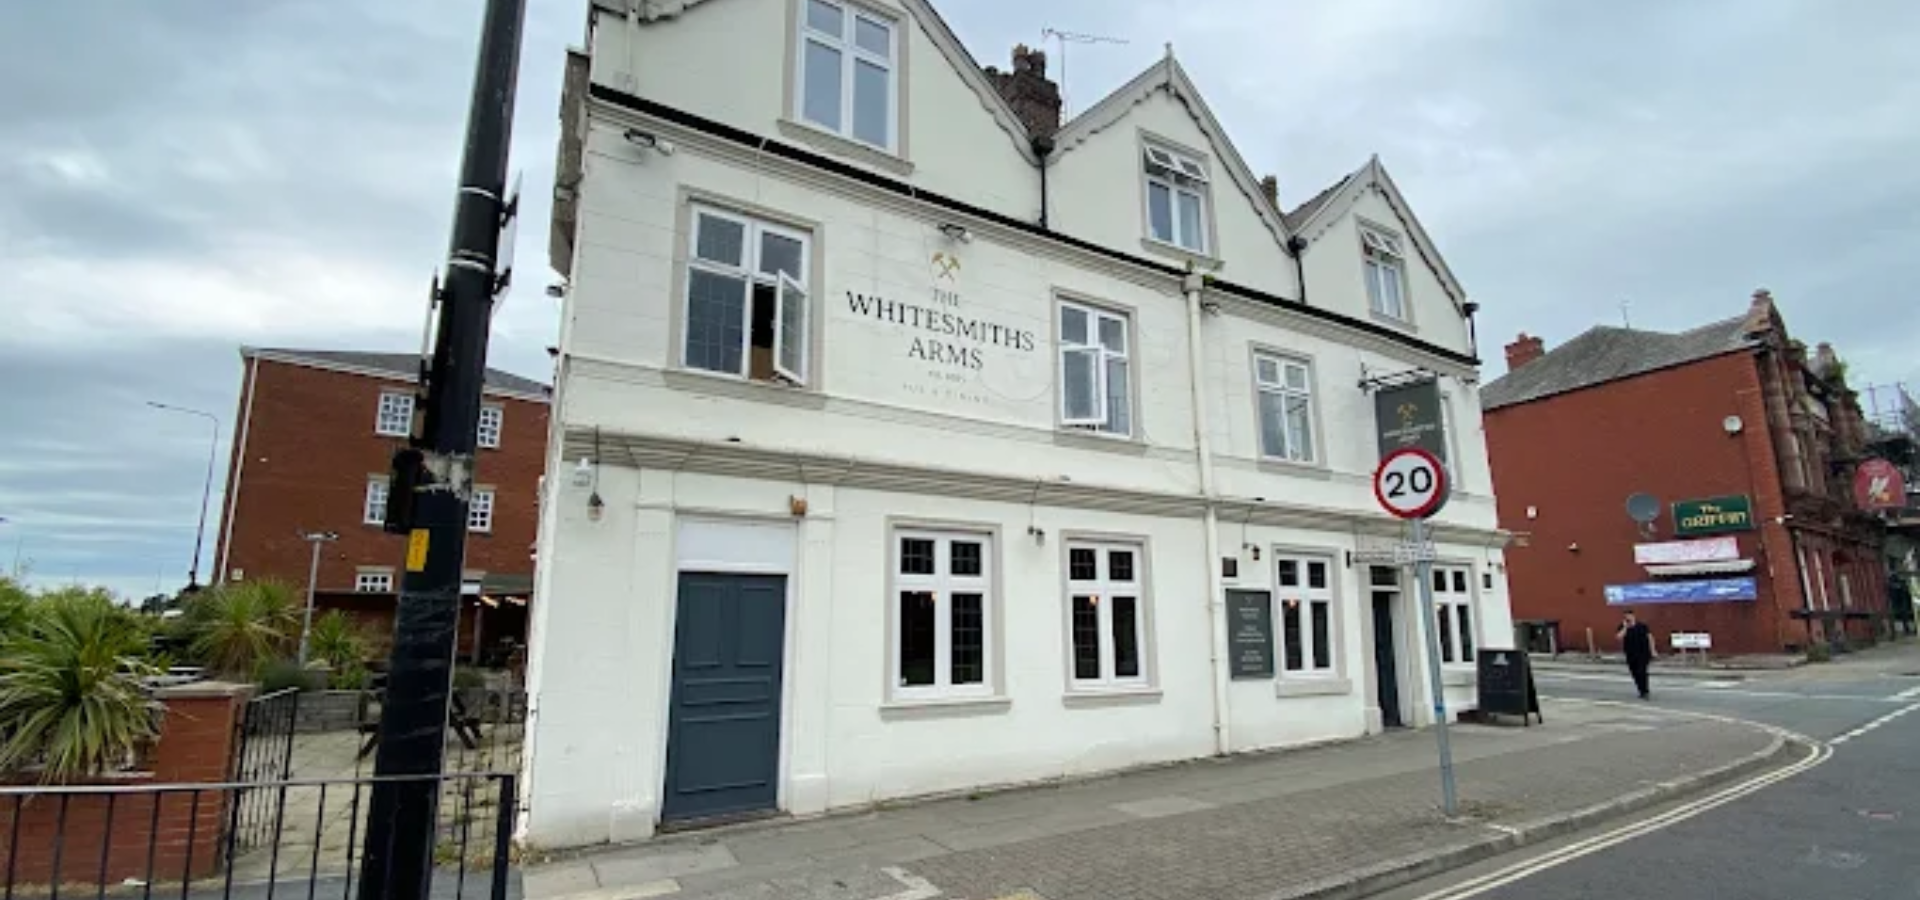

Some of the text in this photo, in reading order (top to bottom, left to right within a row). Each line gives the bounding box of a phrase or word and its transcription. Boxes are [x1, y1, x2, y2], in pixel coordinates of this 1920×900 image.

[933, 288, 960, 307] THE
[846, 290, 1035, 352] WHITESMITHS
[908, 336, 984, 371] ARMS
[1385, 466, 1433, 498] 20
